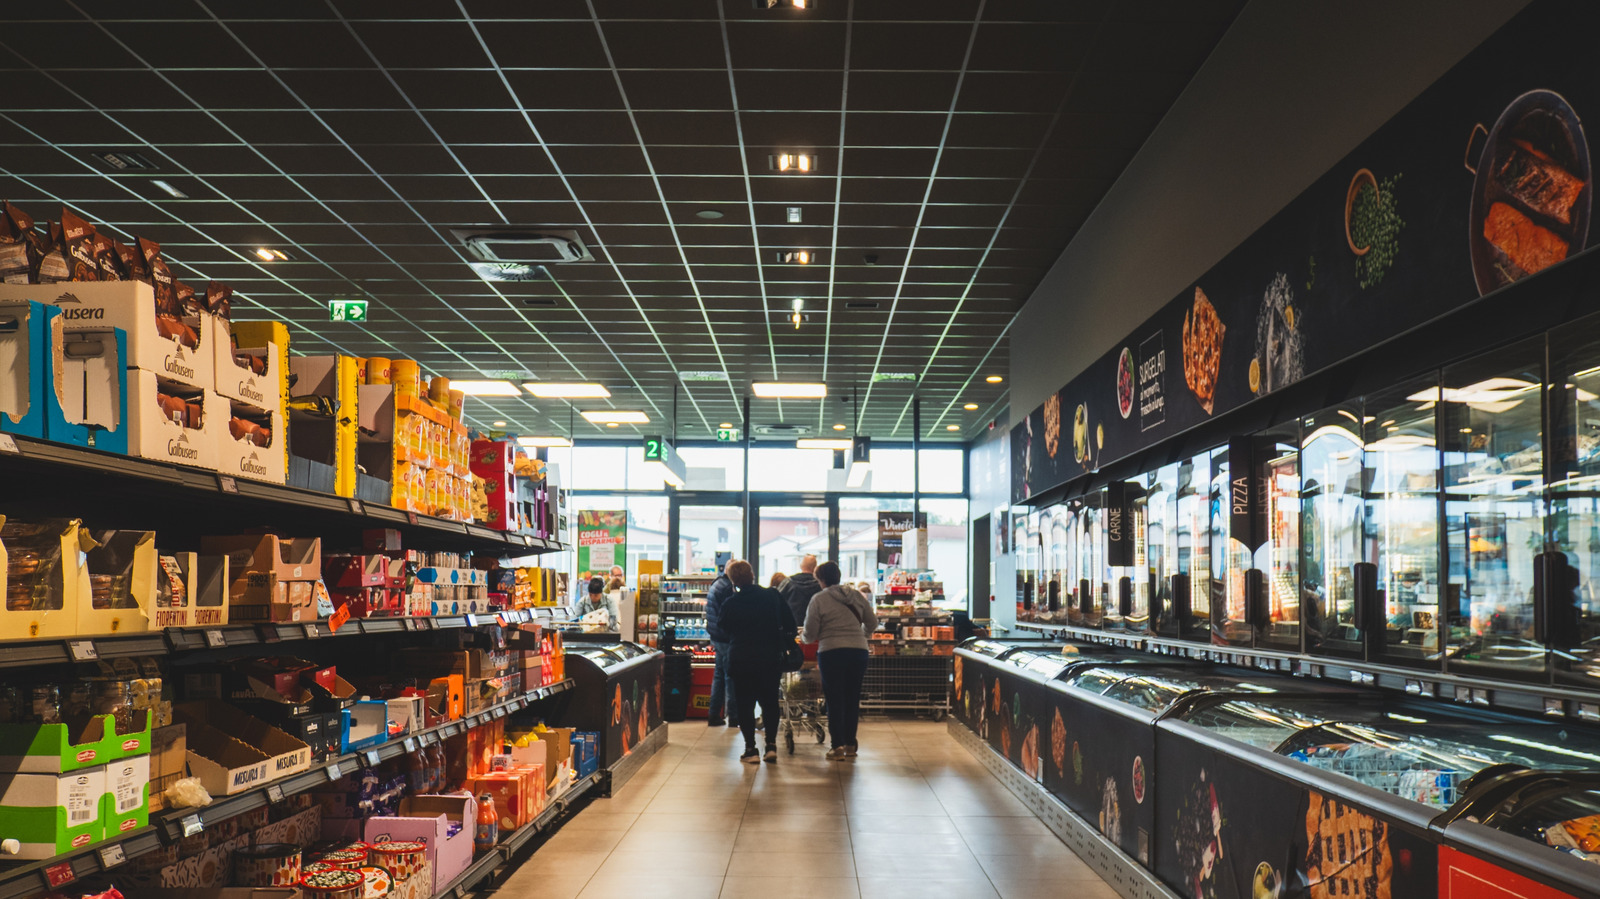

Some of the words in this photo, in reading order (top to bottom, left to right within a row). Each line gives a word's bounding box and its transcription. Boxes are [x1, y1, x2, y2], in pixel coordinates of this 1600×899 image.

[164, 354, 194, 379] Galbusera
[238, 380, 264, 403] Galbusera
[167, 438, 198, 460] Galbusera
[647, 440, 659, 458] 2
[857, 442, 865, 458] 1
[240, 456, 267, 476] Galbusera
[1233, 477, 1248, 515] PIZZA
[581, 530, 603, 539] COGLI
[1109, 507, 1122, 542] CARNE
[156, 610, 188, 627] FIORENTINI
